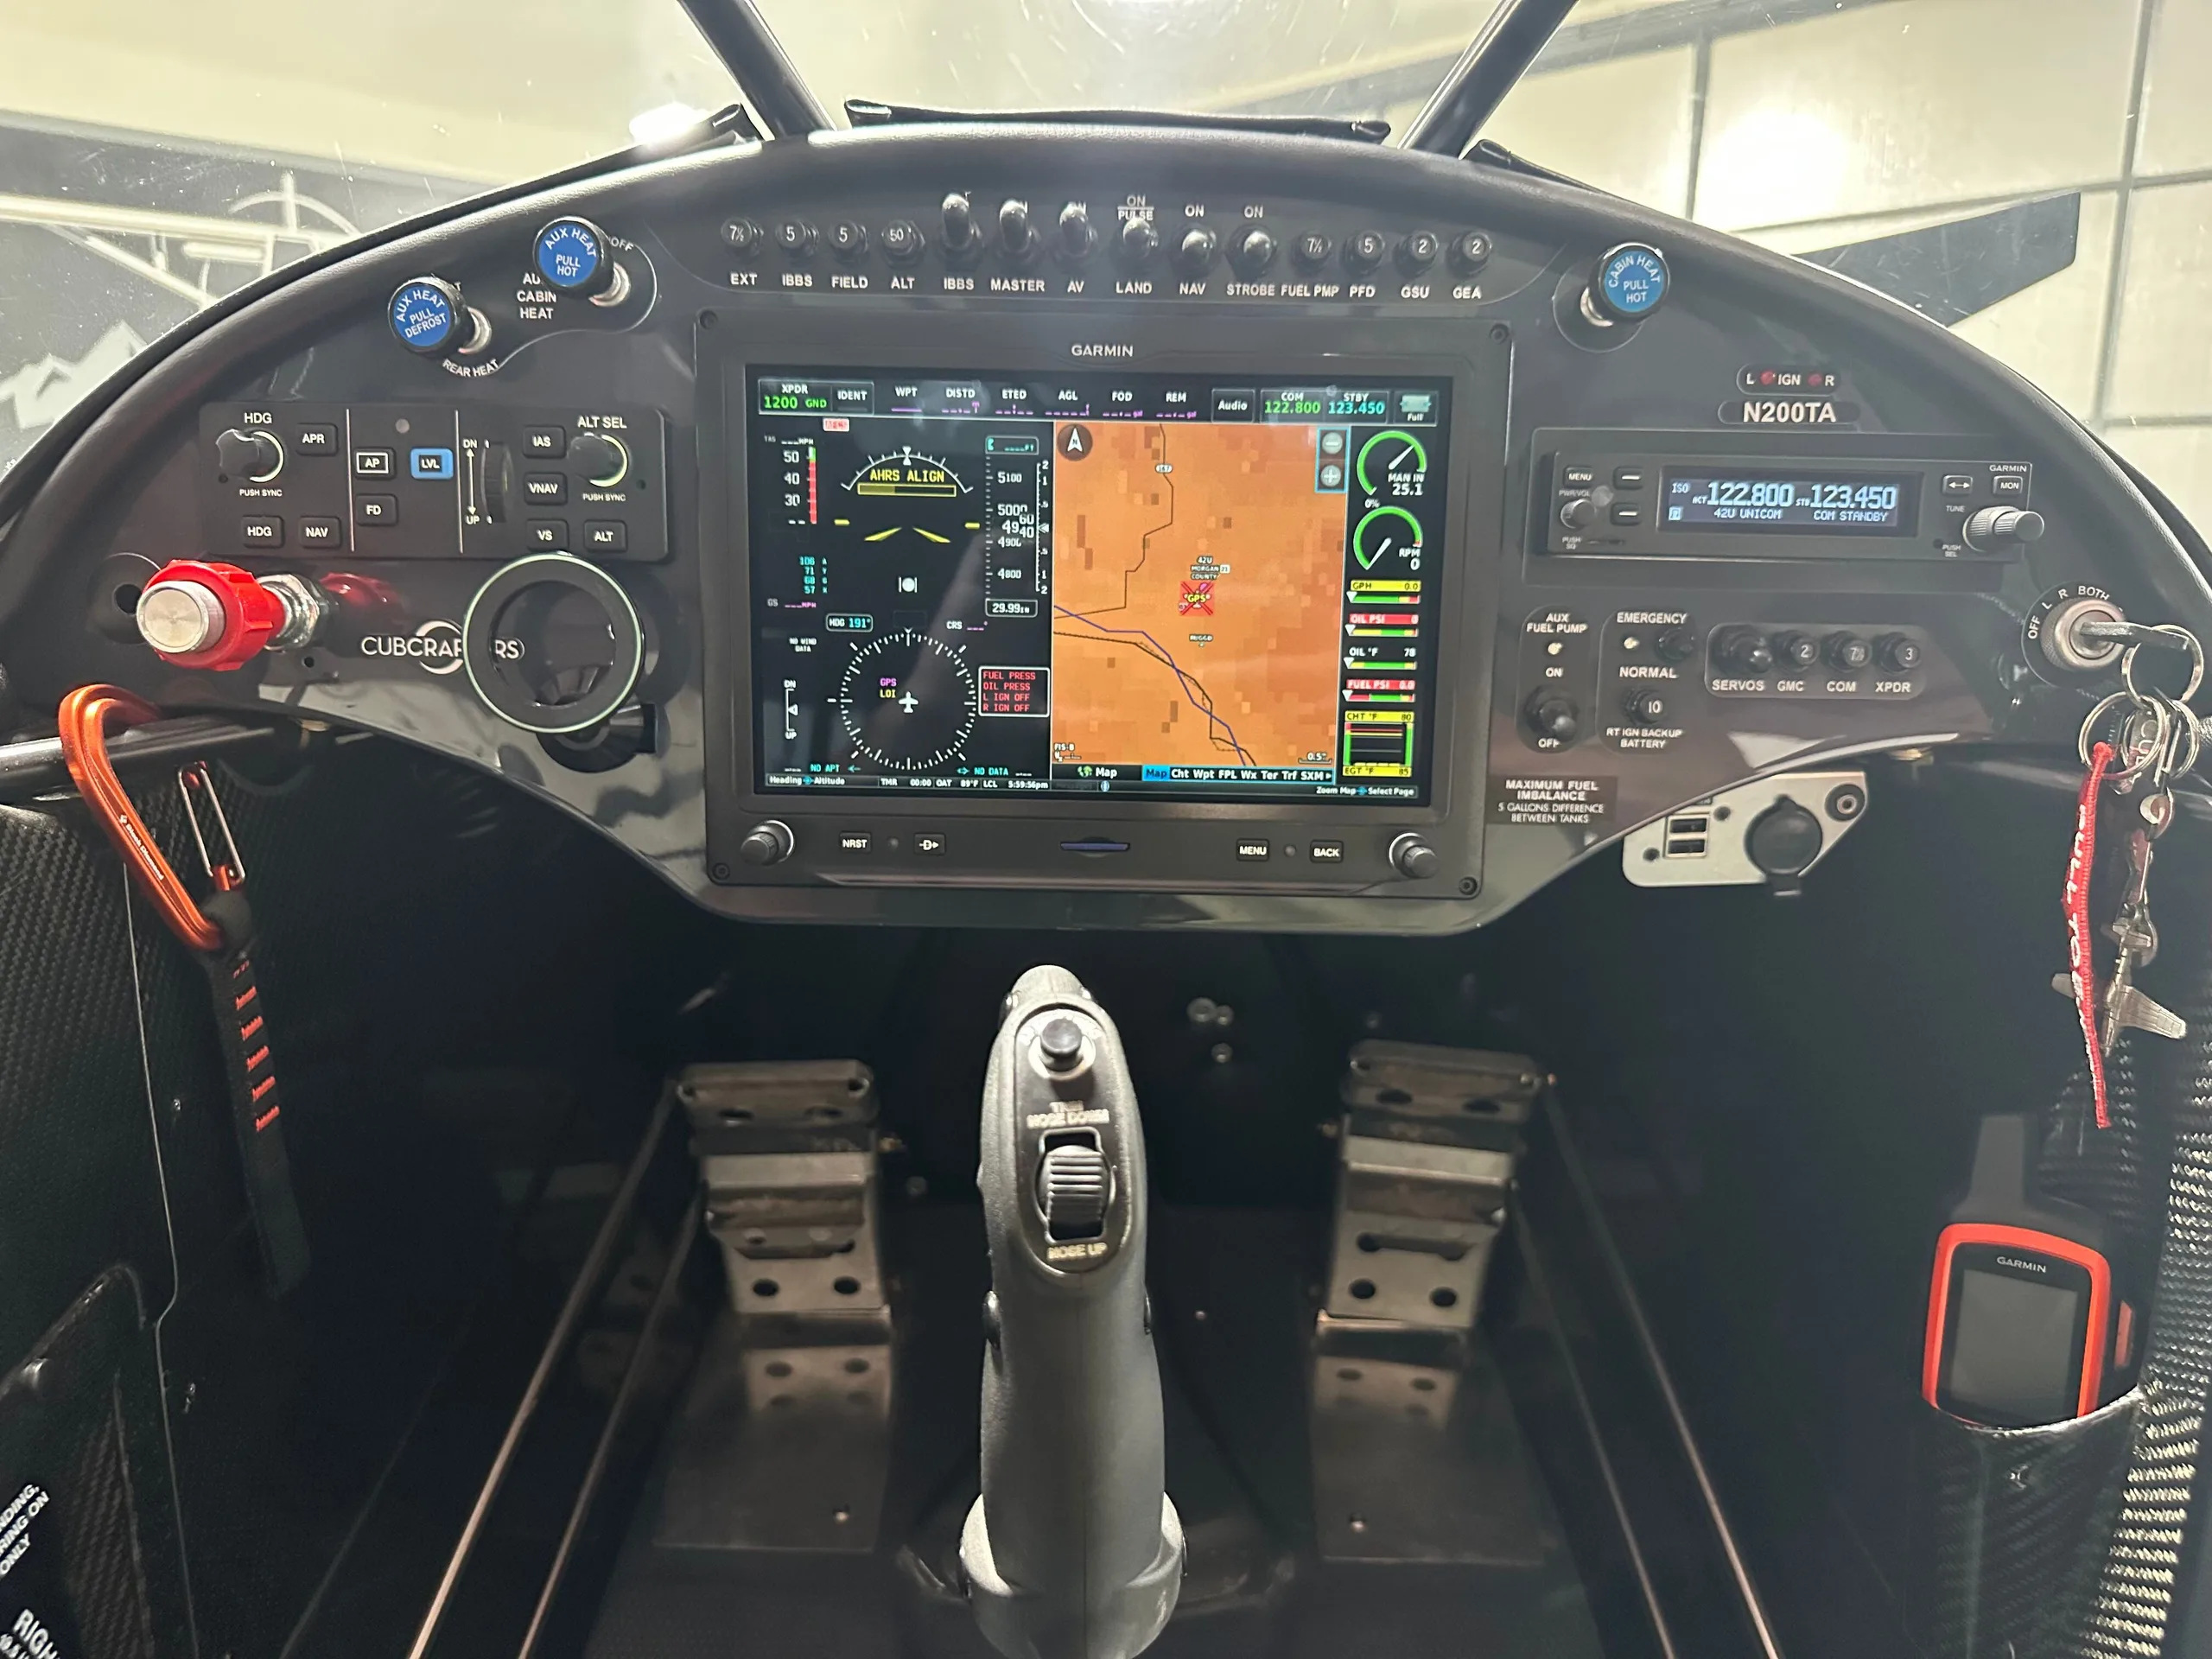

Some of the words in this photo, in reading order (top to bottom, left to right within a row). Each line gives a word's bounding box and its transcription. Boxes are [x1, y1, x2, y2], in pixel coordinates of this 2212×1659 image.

[1127, 195, 1146, 207] ON
[1185, 205, 1205, 217] ON
[1244, 206, 1263, 219] ON
[786, 226, 795, 241] 5
[839, 227, 849, 243] 5
[889, 228, 904, 242] 50
[545, 228, 569, 251] AUX
[572, 228, 597, 257] HEAT
[611, 238, 634, 251] OFF
[1364, 238, 1374, 253] 5
[1419, 239, 1428, 253] 2
[1472, 239, 1482, 253] 2
[556, 255, 581, 267] PULL
[557, 265, 578, 277] HOT
[1609, 256, 1634, 288] CABIN
[1637, 256, 1661, 283] HEAT
[730, 273, 757, 286] EXT
[782, 275, 813, 287] IBBS
[831, 276, 868, 289] FIELD
[891, 277, 915, 289] ALT
[944, 278, 975, 290] IBBS
[990, 279, 1045, 292] MASTER
[1624, 280, 1649, 291] PULL
[1067, 281, 1084, 293] AV
[1116, 282, 1152, 296] LAND
[1179, 283, 1206, 296] NAV
[1227, 283, 1274, 297] STROBE
[1281, 284, 1311, 297] FUEL
[1314, 285, 1339, 298] PMP
[1350, 285, 1375, 298] PFD
[1401, 285, 1430, 299] GSU
[1452, 286, 1482, 300] GEA
[517, 290, 556, 302] CABIN
[1626, 292, 1647, 303] HOT
[397, 295, 412, 323] AUX
[413, 289, 445, 308] HEAT
[410, 308, 435, 324] PULL
[520, 308, 554, 319] HEAT
[404, 313, 447, 338] DEFROST
[1071, 345, 1134, 358] GARMIN
[442, 359, 471, 377] REAR
[474, 359, 499, 377] HEAT
[1746, 373, 1755, 385] L
[1778, 374, 1801, 385] IGN
[1825, 375, 1834, 386] R
[782, 385, 809, 394] XPDR
[895, 387, 918, 397] WPT
[837, 391, 868, 401] IDENT
[1058, 391, 1077, 401] AGL
[1112, 391, 1133, 402] FOD
[1166, 392, 1187, 403] REM
[1281, 392, 1304, 402] COM
[1344, 392, 1370, 403] STBY
[764, 396, 798, 409] 1200
[805, 399, 827, 408] GND
[1218, 400, 1248, 410] Audio
[1264, 401, 1321, 414] 122.800
[1328, 402, 1385, 415] 123.450
[245, 413, 272, 423] HDG
[1743, 402, 1836, 423] N200TA
[577, 416, 600, 429] ALT
[602, 417, 627, 429] SEL
[302, 434, 325, 443] APR
[463, 440, 477, 448] DN
[532, 435, 551, 447] IAS
[365, 458, 380, 467] AP
[784, 451, 799, 463] 50
[421, 458, 440, 469] LVL
[785, 473, 800, 485] 40
[870, 469, 900, 481] AHRS
[907, 470, 944, 482] ALIGN
[998, 472, 1022, 484] 5100
[1389, 474, 1410, 483] MAN
[1413, 474, 1424, 483] IN
[529, 483, 558, 493] VNAV
[1392, 483, 1423, 496] 25.1
[1707, 482, 1795, 506] 122.800
[582, 493, 604, 502] PUSH
[1810, 484, 1897, 509] 123.450
[366, 505, 381, 515] FD
[1714, 508, 1735, 518] 42U
[1740, 509, 1783, 519] UNICOM
[466, 516, 480, 524] UP
[1814, 511, 1835, 521] COM
[1839, 512, 1889, 522] STANDBY
[248, 527, 272, 537] HDG
[306, 527, 328, 537] NAV
[537, 531, 553, 541] VS
[594, 531, 613, 542] ALT
[1399, 548, 1421, 557] RPM
[1187, 594, 1206, 603] GPS
[1546, 613, 1570, 623] AUX
[1617, 612, 1688, 625] EMERGENCY
[2028, 615, 2041, 639] OFF
[2042, 601, 2053, 610] L
[2058, 588, 2069, 599] R
[2078, 586, 2110, 601] BOTH
[1527, 623, 1554, 632] FUEL
[1557, 623, 1589, 634] PUMP
[1349, 647, 1365, 657] OIL
[1801, 645, 1809, 658] 2
[1905, 648, 1914, 660] 3
[983, 671, 1004, 680] FUEL
[1009, 671, 1036, 680] PRESS
[1546, 667, 1564, 677] ON
[1619, 666, 1679, 679] NORMAL
[880, 678, 897, 687] GPS
[983, 682, 999, 690] OIL
[1004, 683, 1031, 691] PRESS
[1712, 680, 1766, 691] SERVOS
[1777, 680, 1804, 692] GMC
[1827, 681, 1857, 692] COM
[1875, 681, 1911, 693] XPDR
[994, 693, 1010, 702] IGN
[1014, 693, 1030, 702] OFF
[1649, 700, 1662, 714] 10
[1606, 728, 1619, 736] RT
[1622, 728, 1639, 737] IGN
[1642, 728, 1683, 738] BACKUP
[1620, 739, 1667, 748] BATTERY
[1096, 767, 1117, 779] Map
[1146, 769, 1167, 779] Map
[1172, 769, 1189, 779] Cht
[1193, 770, 1215, 780] Wpt
[1218, 771, 1237, 779] FPL
[1241, 771, 1257, 779] Wx
[1261, 771, 1278, 780] Ter
[1282, 771, 1296, 780] Trf
[1300, 772, 1323, 781] SXM
[769, 776, 802, 786] Heading
[1506, 780, 1563, 791] MAXIMUM
[1567, 780, 1599, 791] FUEL
[1517, 791, 1586, 801] IMBALANCE
[1498, 802, 1504, 812] 5
[1507, 803, 1548, 813] GALLONS
[1552, 804, 1605, 814] DIFFERENCE
[1511, 814, 1555, 823] BETWEEN
[1560, 814, 1589, 823] TANKS
[842, 839, 868, 849] NRST
[1239, 846, 1268, 856] MENU
[1313, 847, 1340, 858] BACK
[1997, 1256, 2047, 1274] GARMIN
[28, 1491, 49, 1517] ON
